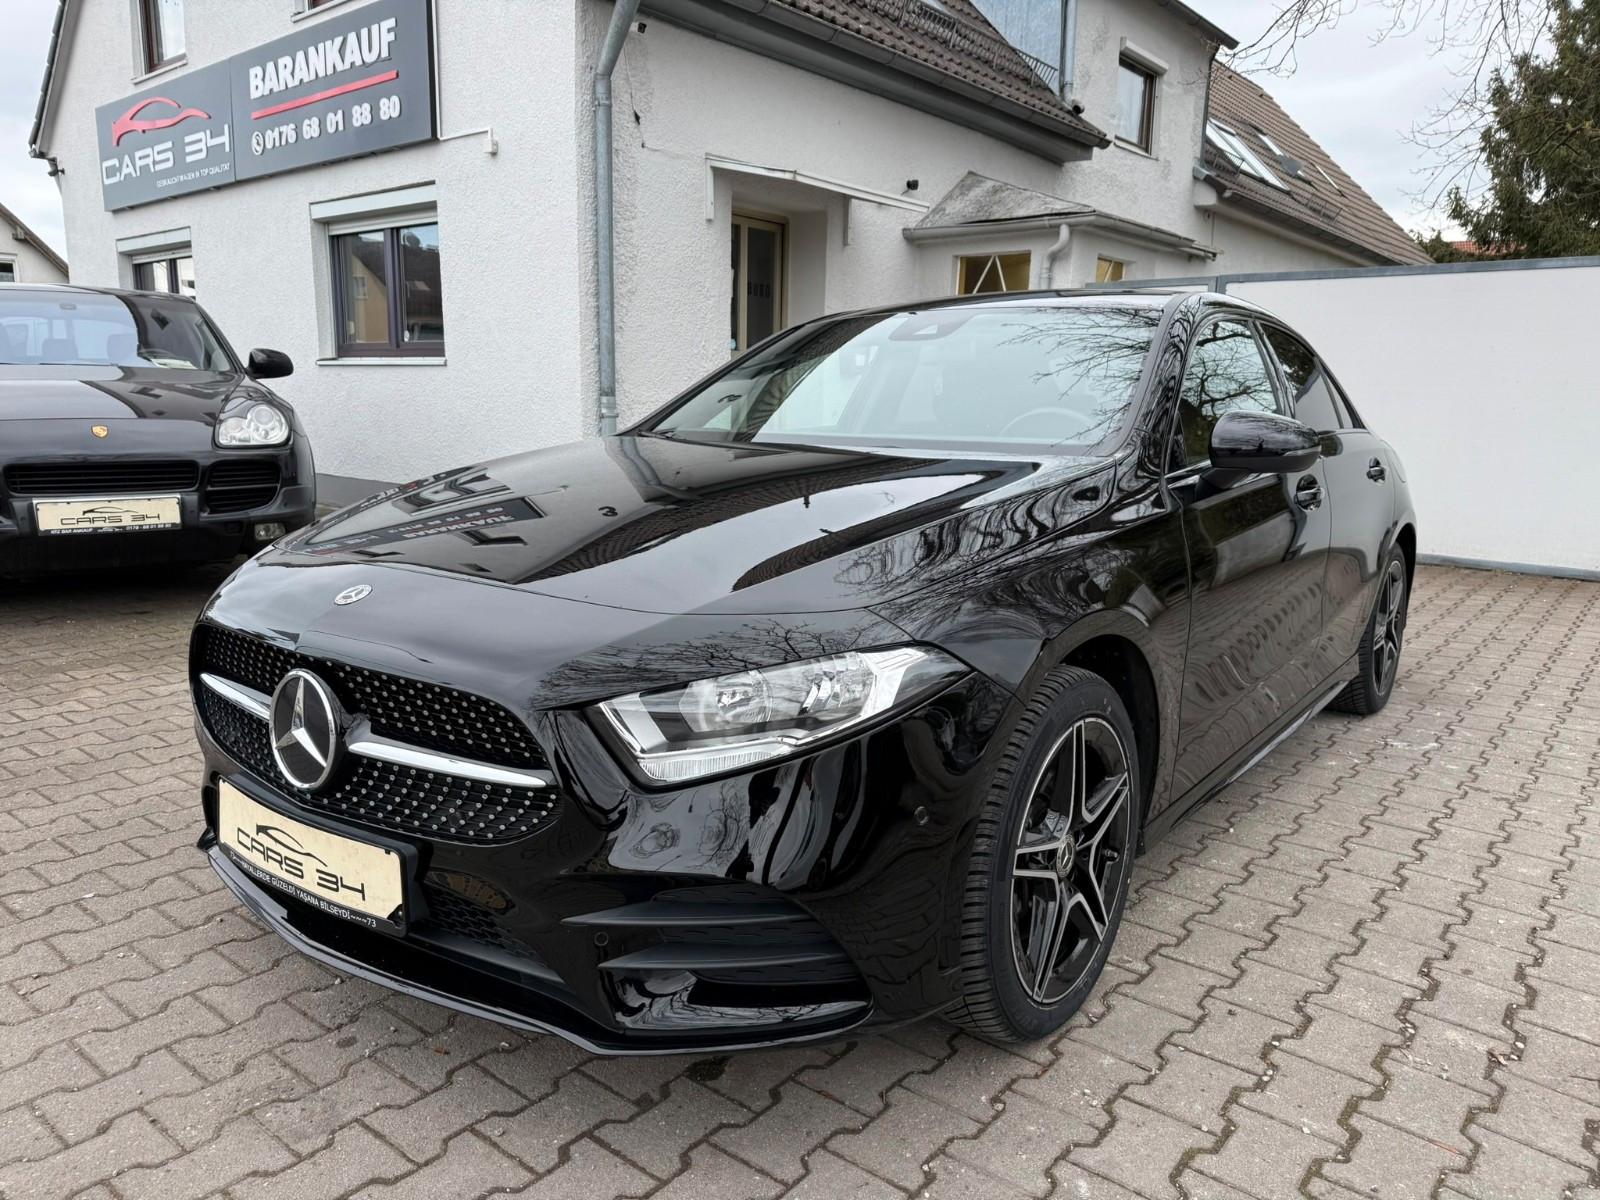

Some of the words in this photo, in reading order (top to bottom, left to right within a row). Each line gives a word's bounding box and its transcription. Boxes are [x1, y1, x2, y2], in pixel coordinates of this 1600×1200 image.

[249, 17, 397, 100] BARANKAUF
[265, 123, 297, 150] 0176
[302, 116, 321, 140] 68
[327, 110, 344, 133] 01
[352, 103, 373, 127] 88
[379, 95, 401, 120] 80
[102, 140, 174, 185] CARS
[184, 124, 230, 160] 34
[60, 515, 122, 526] CARS
[130, 513, 160, 523] 34
[237, 827, 304, 880] CARS
[315, 868, 366, 901] 34
